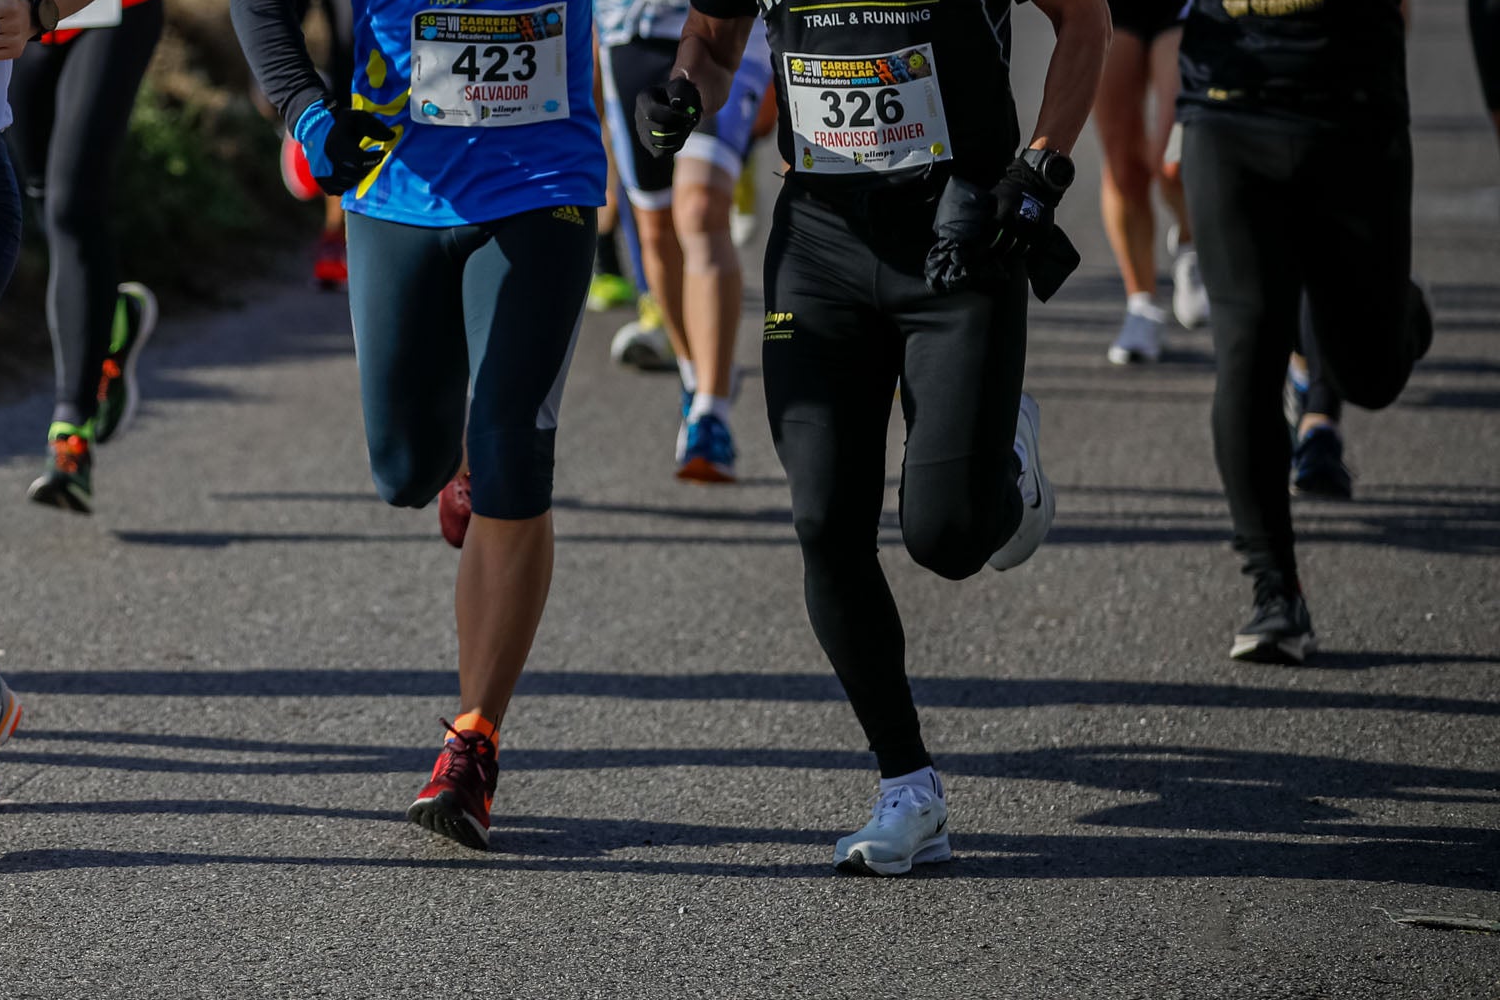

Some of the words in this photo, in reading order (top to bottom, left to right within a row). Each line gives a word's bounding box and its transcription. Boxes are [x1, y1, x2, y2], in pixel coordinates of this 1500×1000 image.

[420, 16, 435, 25] 26
[447, 16, 459, 31] VII
[460, 16, 517, 25] CARRERA
[804, 13, 844, 28] TRAIL
[849, 12, 859, 24] &
[863, 9, 931, 24] RUNNING
[460, 25, 517, 33] POPULAR
[451, 44, 537, 82] 423
[821, 61, 873, 71] CARRERA
[822, 69, 875, 78] POPULAR
[821, 77, 850, 85] Secaderos
[464, 85, 528, 101] SALVADOR
[492, 105, 522, 114] olimpo
[819, 87, 905, 128] 326
[814, 131, 878, 148] FRANCISCO
[882, 123, 925, 144] JAVIER
[864, 150, 895, 159] olimpo
